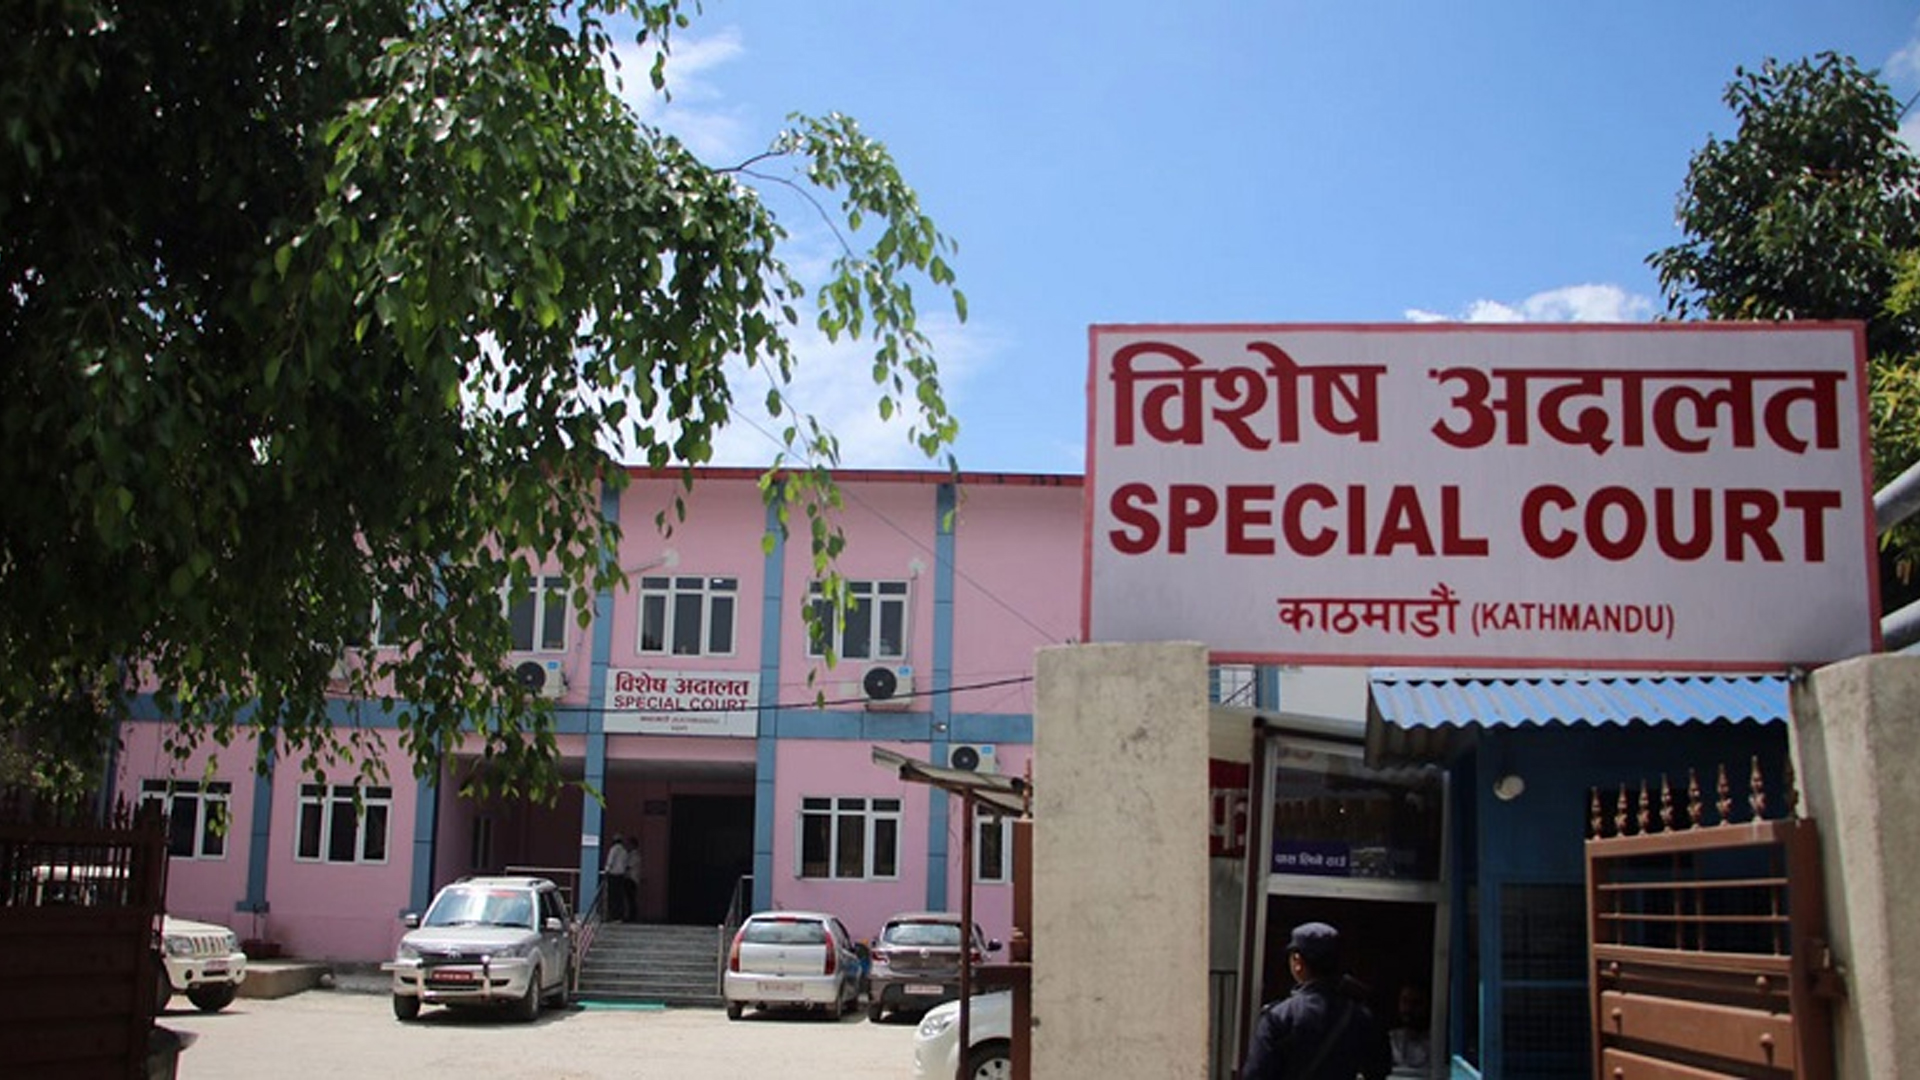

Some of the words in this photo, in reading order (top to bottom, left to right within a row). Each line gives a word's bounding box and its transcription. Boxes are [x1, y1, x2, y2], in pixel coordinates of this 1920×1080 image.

[1112, 342, 1386, 451] विशेष
[1428, 368, 1845, 455] अदालत
[1110, 483, 1489, 557] SPECIAL
[1520, 485, 1841, 563] COURT
[1278, 583, 1460, 639] काठमाडौं
[1471, 602, 1674, 640] (KATHMANDU)
[614, 695, 684, 711] SPECIAL
[689, 697, 749, 712] COURT
[615, 671, 667, 693] विशेष
[674, 678, 750, 697] अदालत
